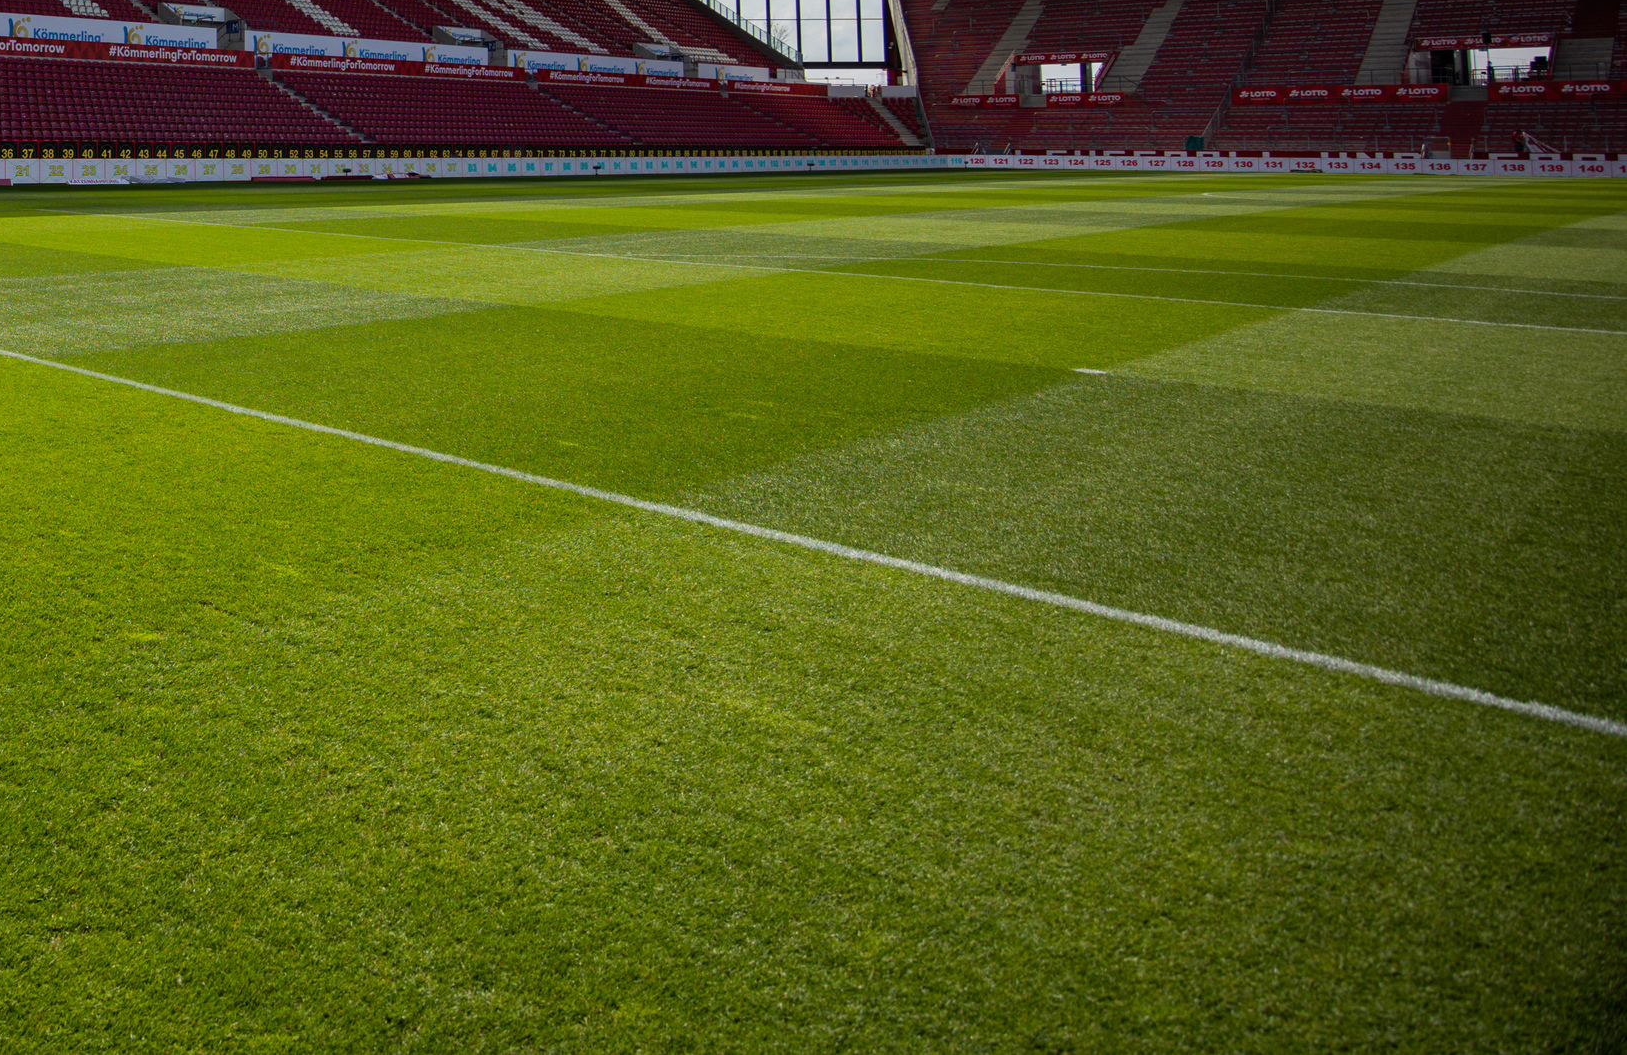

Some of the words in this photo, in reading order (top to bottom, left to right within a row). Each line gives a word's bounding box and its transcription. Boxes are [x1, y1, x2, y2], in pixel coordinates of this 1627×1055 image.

[109, 46, 237, 62] #KömmerlingForTomorrow
[290, 56, 395, 72] #KömmerlingForTomorrow
[425, 62, 513, 77] #KömmerlingForTomorrow
[549, 71, 625, 84] #KömmerlingForTomorrow
[1511, 85, 1545, 93] LOTTO
[1574, 84, 1610, 92] LOTTO
[959, 96, 980, 104] LOTTO
[1, 148, 14, 159] 36
[22, 148, 34, 159] 37
[42, 148, 55, 159] 38
[62, 148, 74, 159] 39
[81, 148, 94, 159] 40
[101, 149, 112, 159] 41
[119, 149, 131, 159] 42
[138, 149, 150, 159] 43
[156, 149, 167, 159] 44
[174, 149, 185, 159] 45
[191, 149, 202, 159] 46
[15, 165, 30, 177] 21
[49, 165, 64, 177] 22
[83, 165, 96, 176] 23
[114, 165, 127, 176] 24
[1329, 161, 1348, 169] 133
[1395, 162, 1416, 170] 135
[1466, 163, 1487, 171] 137
[1542, 164, 1564, 172] 139
